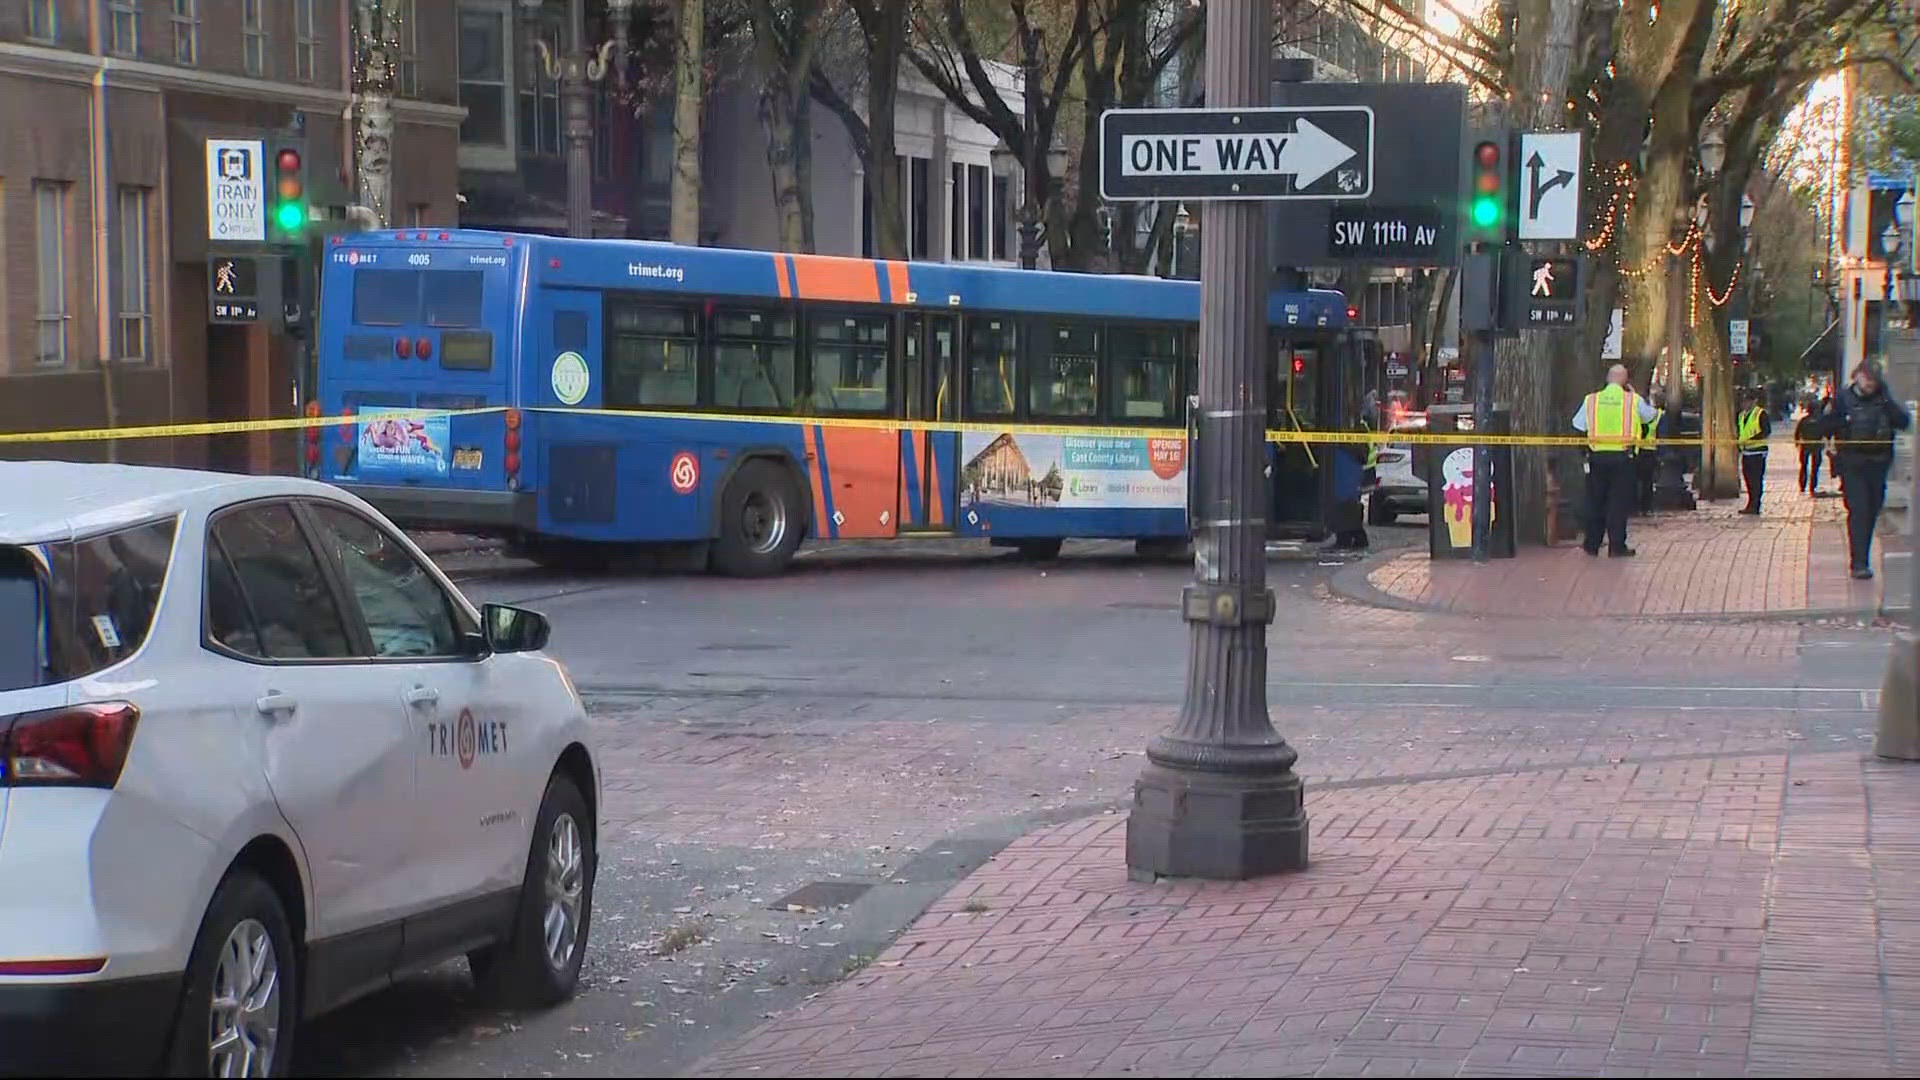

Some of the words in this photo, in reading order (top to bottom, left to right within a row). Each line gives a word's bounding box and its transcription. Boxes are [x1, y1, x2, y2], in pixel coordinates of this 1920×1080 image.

[1131, 139, 1201, 172] ONE
[1216, 138, 1288, 171] WAY
[217, 184, 257, 200] TRAIN
[216, 203, 256, 219] ONLY
[1335, 221, 1365, 245] SW
[1372, 220, 1407, 245] 11th
[1414, 225, 1436, 245] Av
[408, 254, 430, 265] 4005
[470, 255, 506, 266] trimet.org
[628, 262, 683, 281] trimet.org
[1530, 310, 1542, 320] SW
[1065, 438, 1096, 448] Discover
[1097, 439, 1113, 451] your
[1115, 440, 1131, 448] new
[1152, 440, 1182, 450] OPENING
[1072, 452, 1088, 462] East
[1089, 452, 1114, 466] County
[1115, 452, 1140, 466] Library
[1153, 451, 1168, 460] MAY
